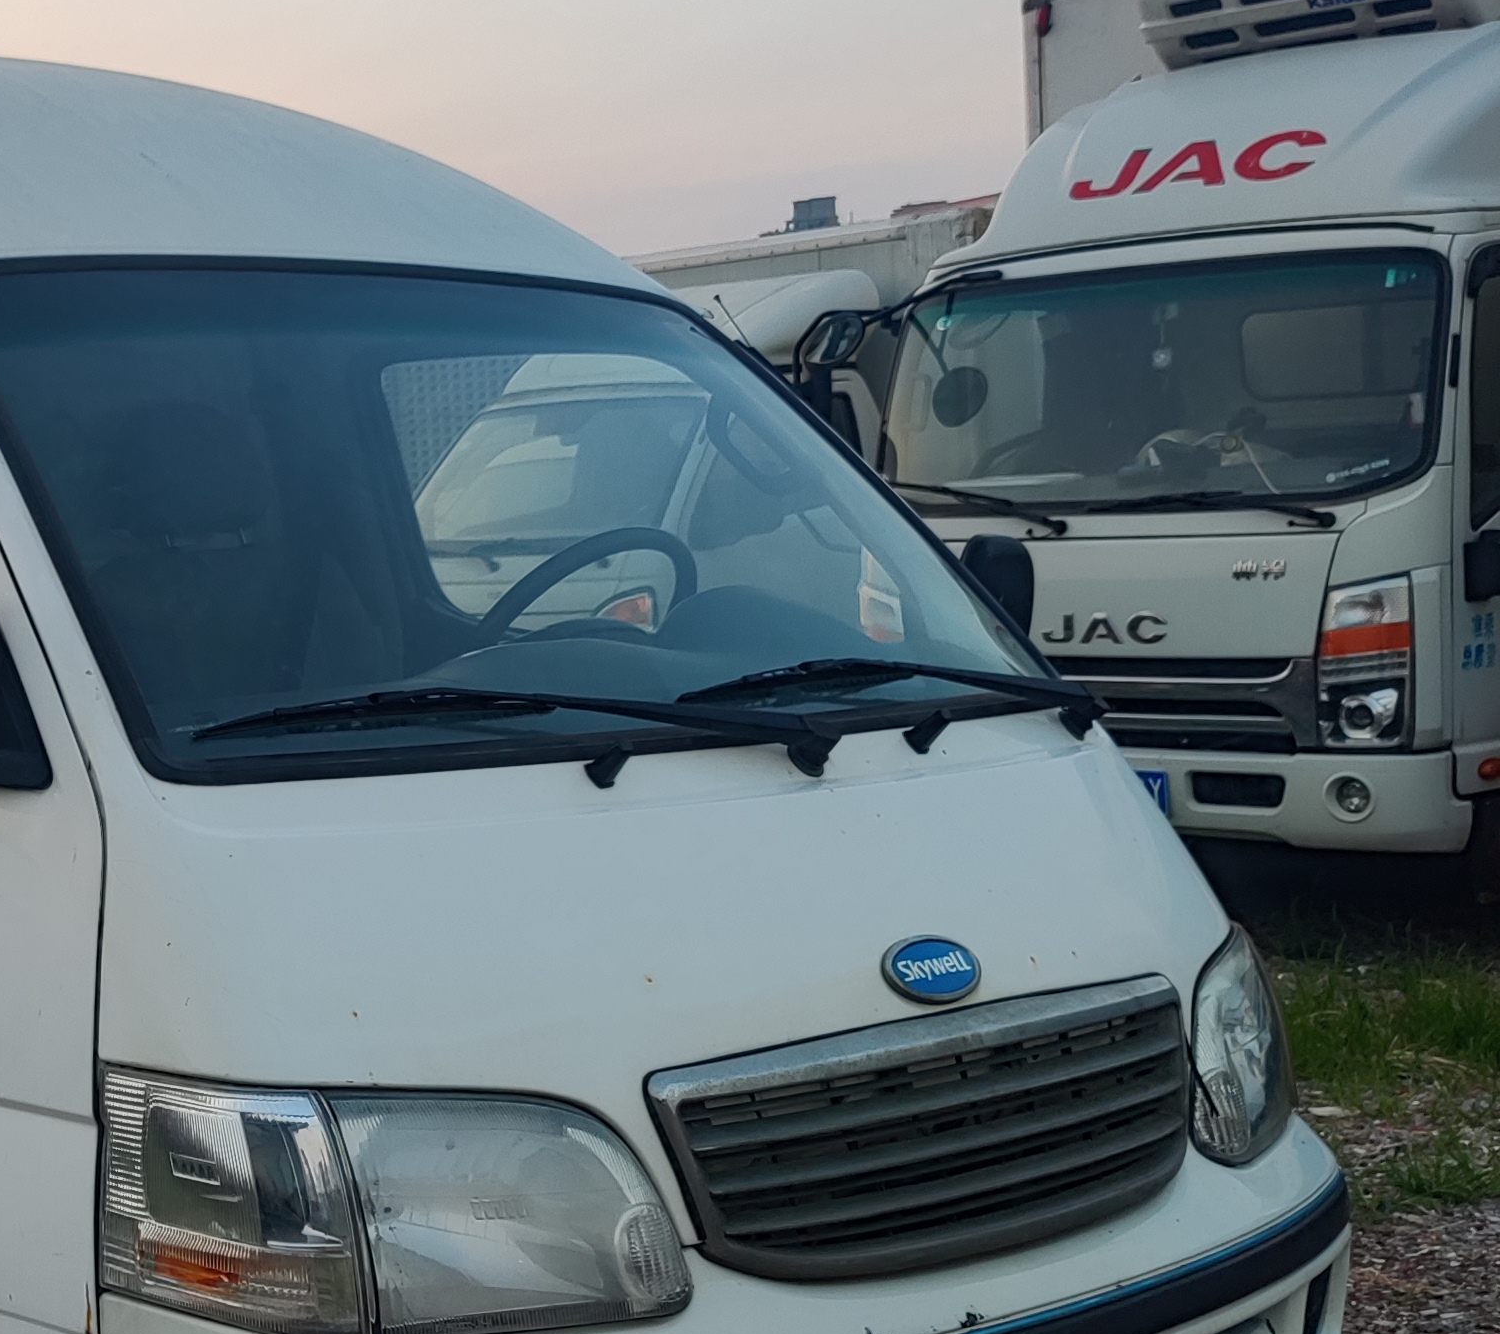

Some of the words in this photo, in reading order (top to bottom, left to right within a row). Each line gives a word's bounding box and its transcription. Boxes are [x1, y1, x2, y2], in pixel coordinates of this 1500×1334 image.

[1069, 130, 1327, 201] JAC
[1041, 610, 1168, 644] JAC
[897, 950, 972, 982] Skywell
